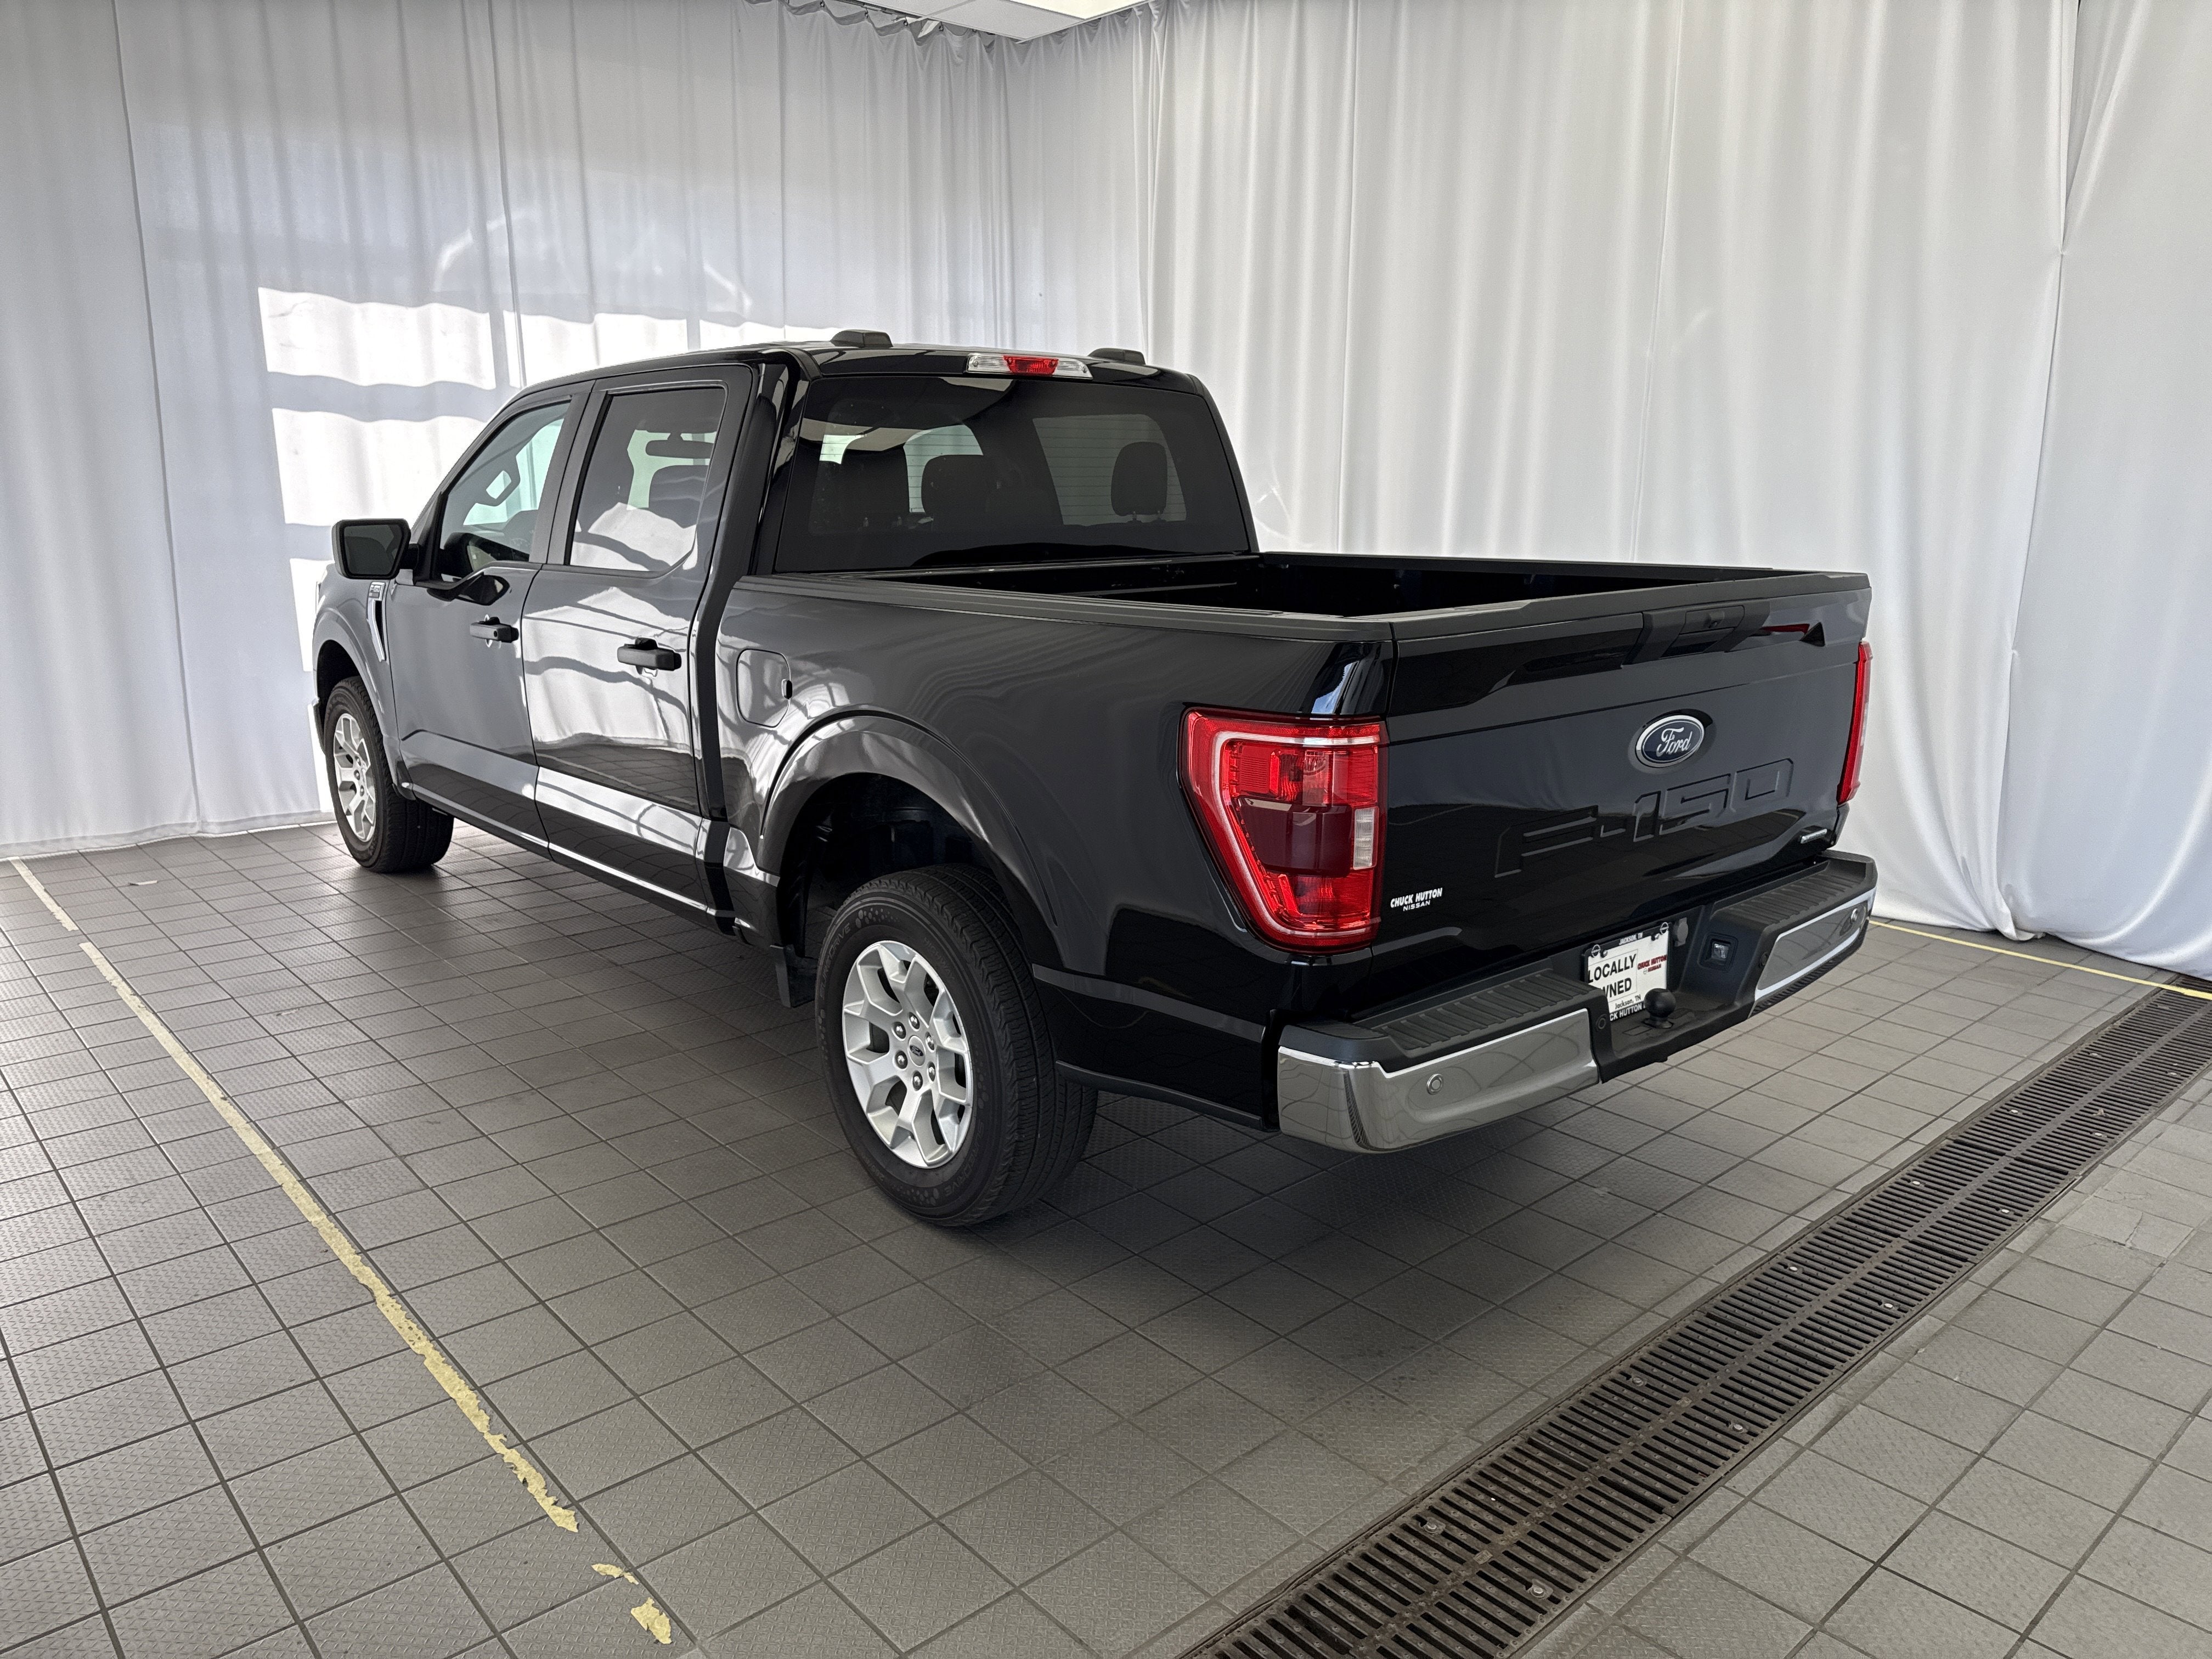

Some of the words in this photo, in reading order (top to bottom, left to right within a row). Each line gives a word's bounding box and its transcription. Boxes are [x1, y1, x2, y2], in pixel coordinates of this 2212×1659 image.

[1656, 727, 1693, 757] Ford
[1494, 758, 1794, 878] F-150
[1390, 894, 1414, 908] CHUCK
[1415, 887, 1443, 902] HUTTON
[1403, 900, 1431, 912] NISSAN
[1588, 953, 1637, 983] LOCALLY
[1602, 978, 1632, 997] NED
[1635, 994, 1641, 1002] TN
[1619, 1003, 1643, 1018] HUTTON
